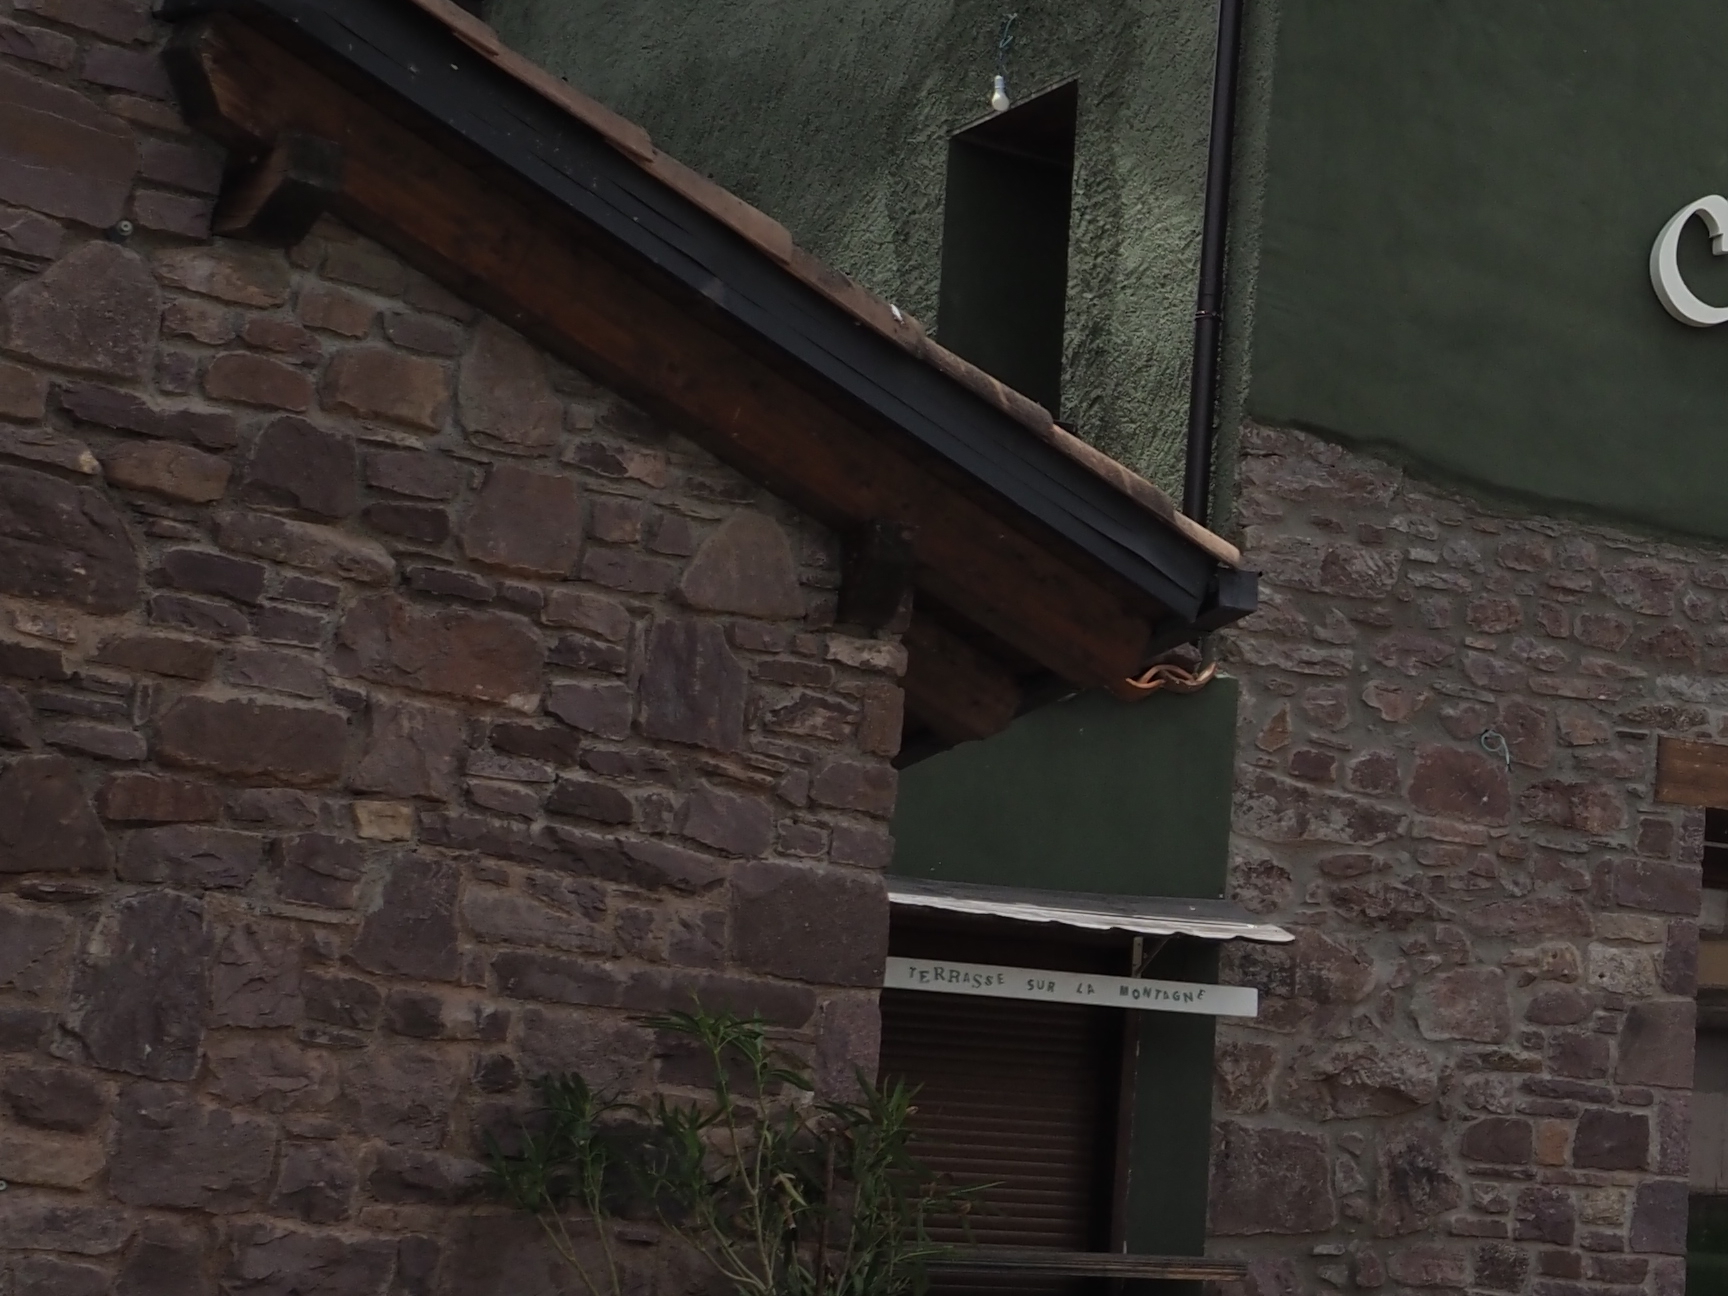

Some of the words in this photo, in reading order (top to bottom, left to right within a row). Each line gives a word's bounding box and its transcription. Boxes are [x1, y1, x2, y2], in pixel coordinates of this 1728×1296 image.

[908, 966, 1005, 989] TERRASSE
[1026, 978, 1056, 992] SUR
[1076, 982, 1095, 995] LA
[1118, 984, 1206, 1003] MONTAGNE
